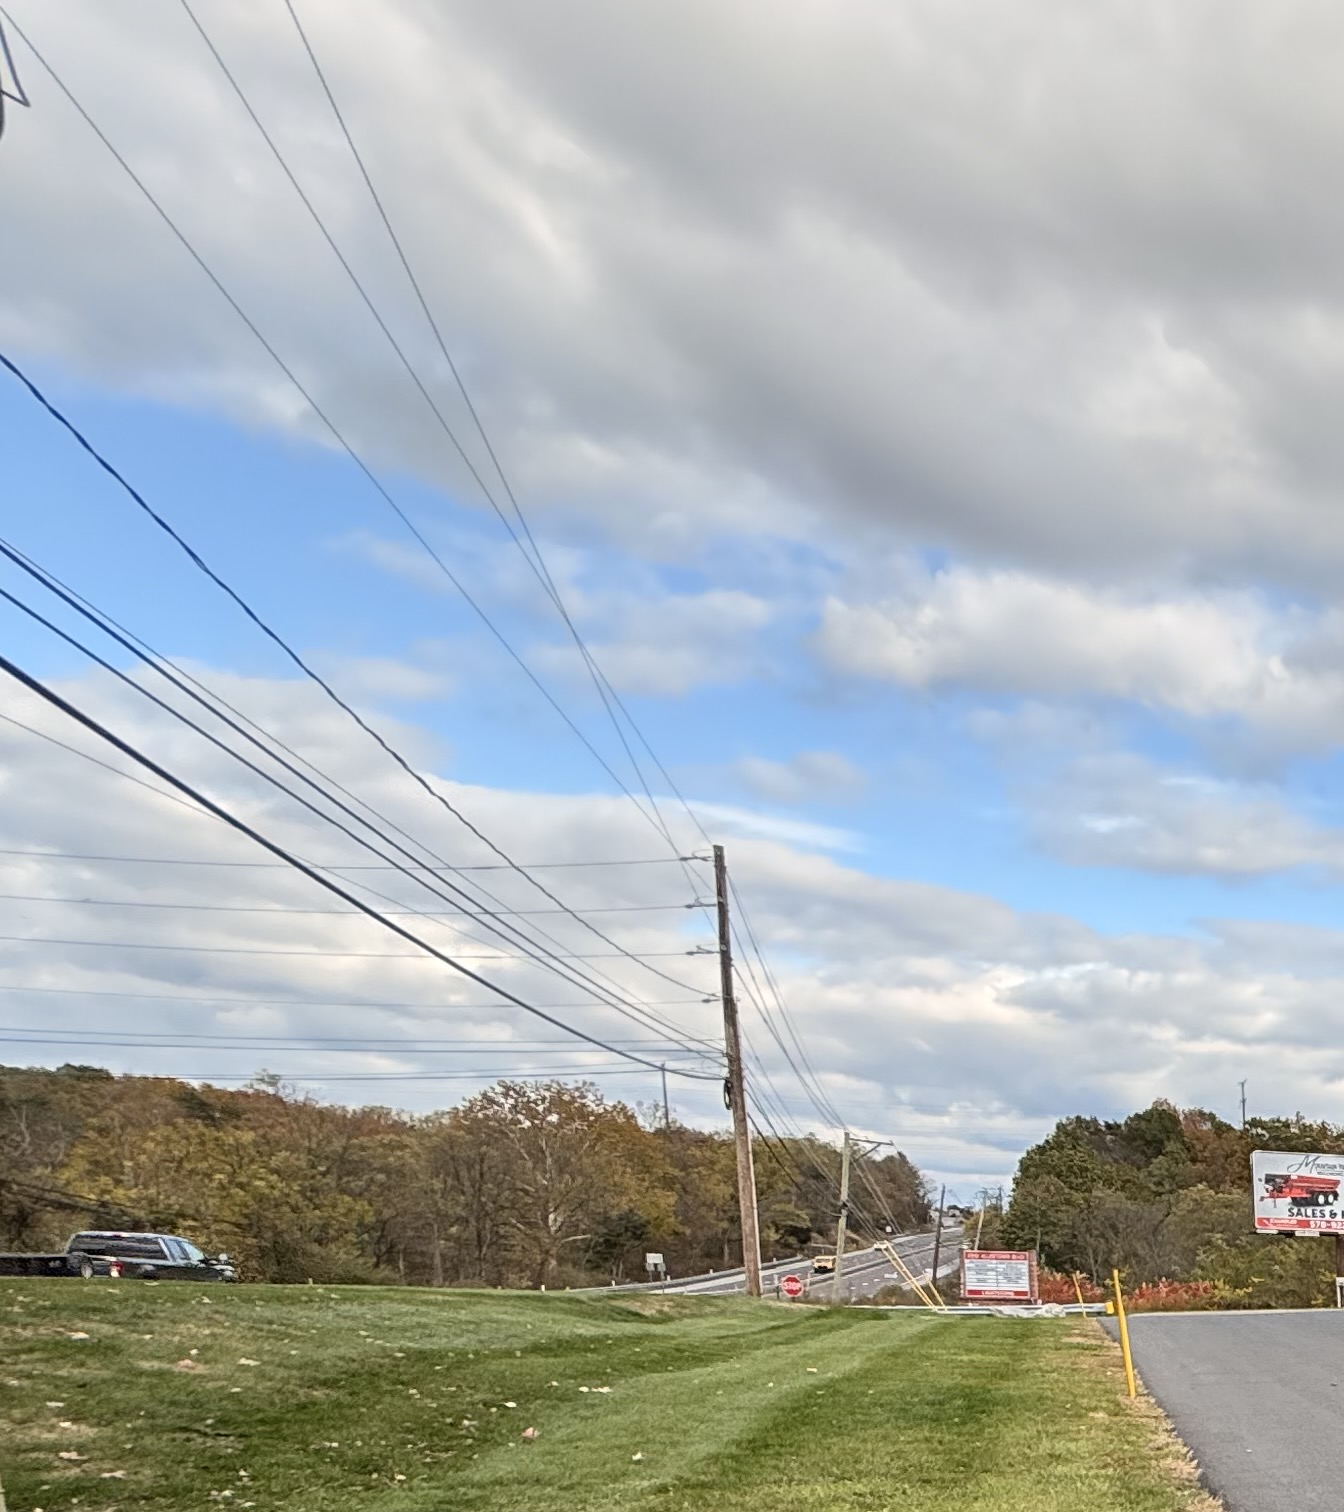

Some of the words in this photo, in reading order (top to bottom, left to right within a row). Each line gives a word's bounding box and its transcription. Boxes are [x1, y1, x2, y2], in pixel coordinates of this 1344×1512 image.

[1288, 1206, 1326, 1219] SALES
[1329, 1209, 1338, 1220] &
[783, 1281, 801, 1291] STOP
